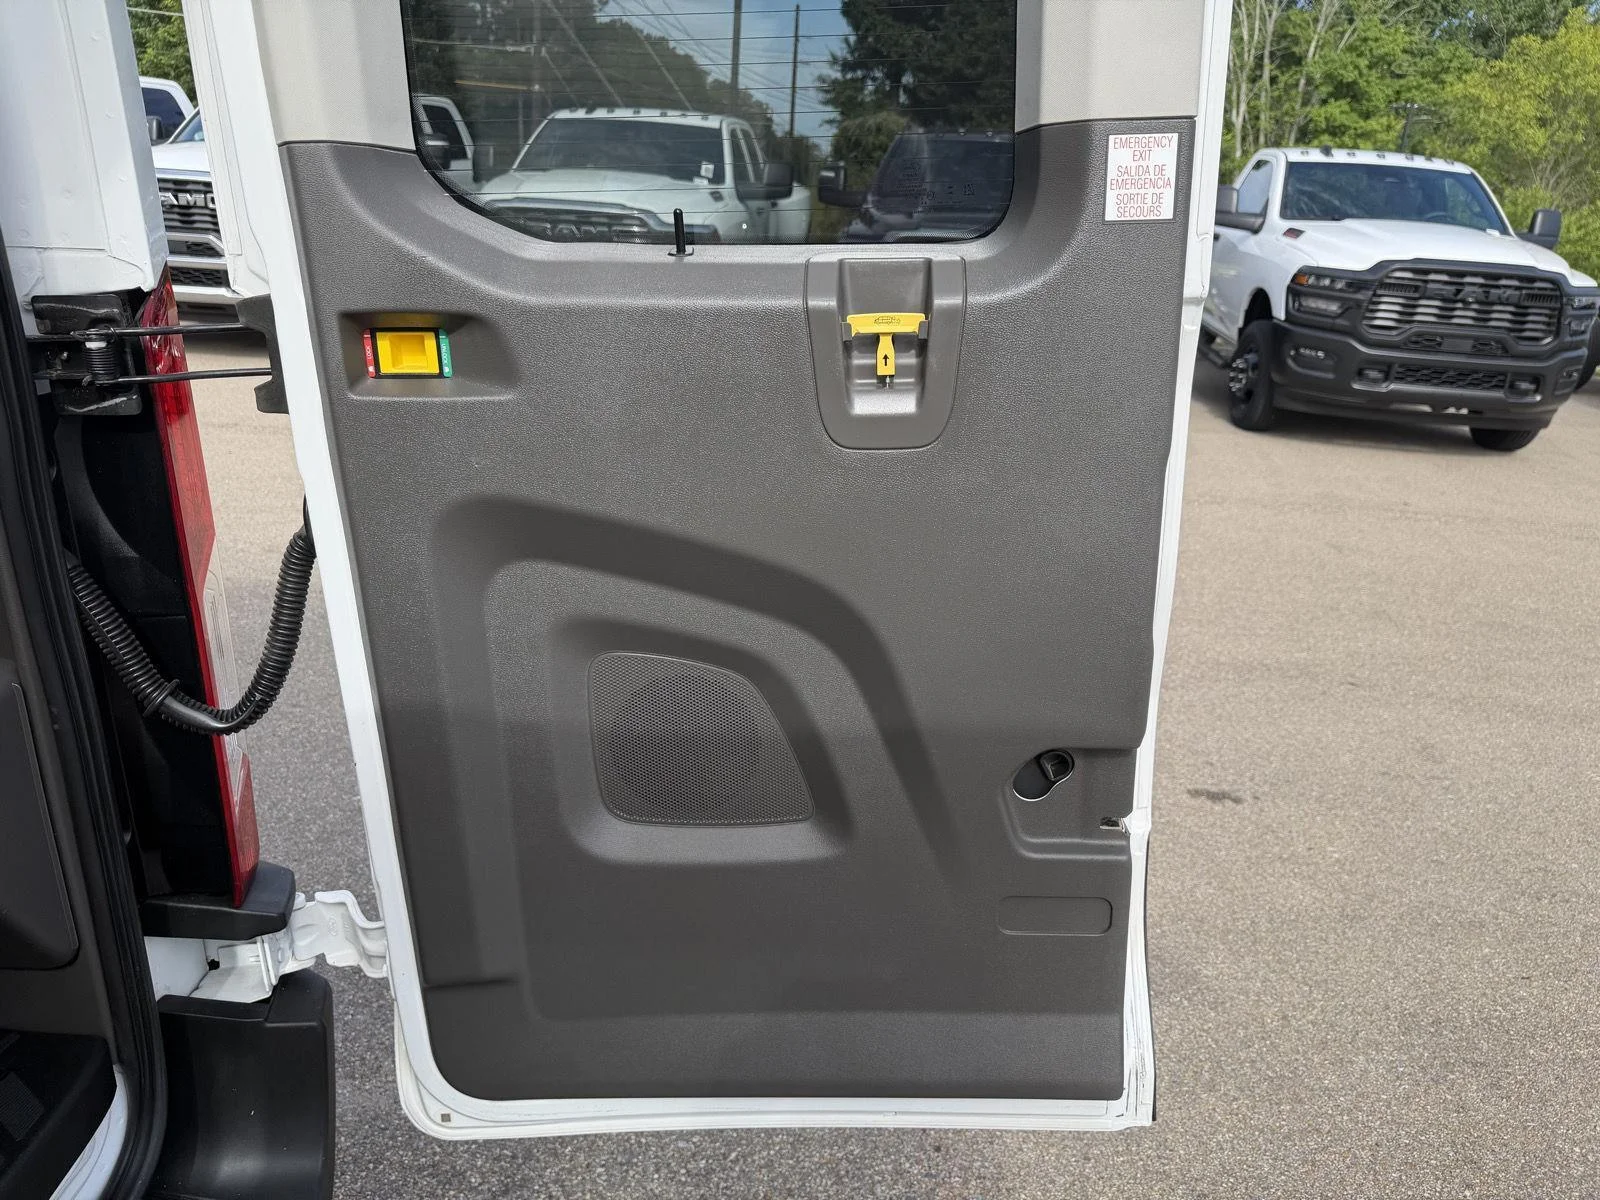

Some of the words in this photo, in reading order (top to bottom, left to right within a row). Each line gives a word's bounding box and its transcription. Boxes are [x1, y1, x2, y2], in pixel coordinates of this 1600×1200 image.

[1113, 135, 1174, 150] EMERGENCY
[1132, 149, 1153, 162] EXIT
[1116, 165, 1151, 178] SALIDA
[1153, 164, 1167, 177] DE
[1110, 177, 1172, 190] EMERGENCIA
[1115, 193, 1149, 206] SORTIE
[1151, 192, 1164, 205] DE
[1116, 205, 1162, 218] SECOURS
